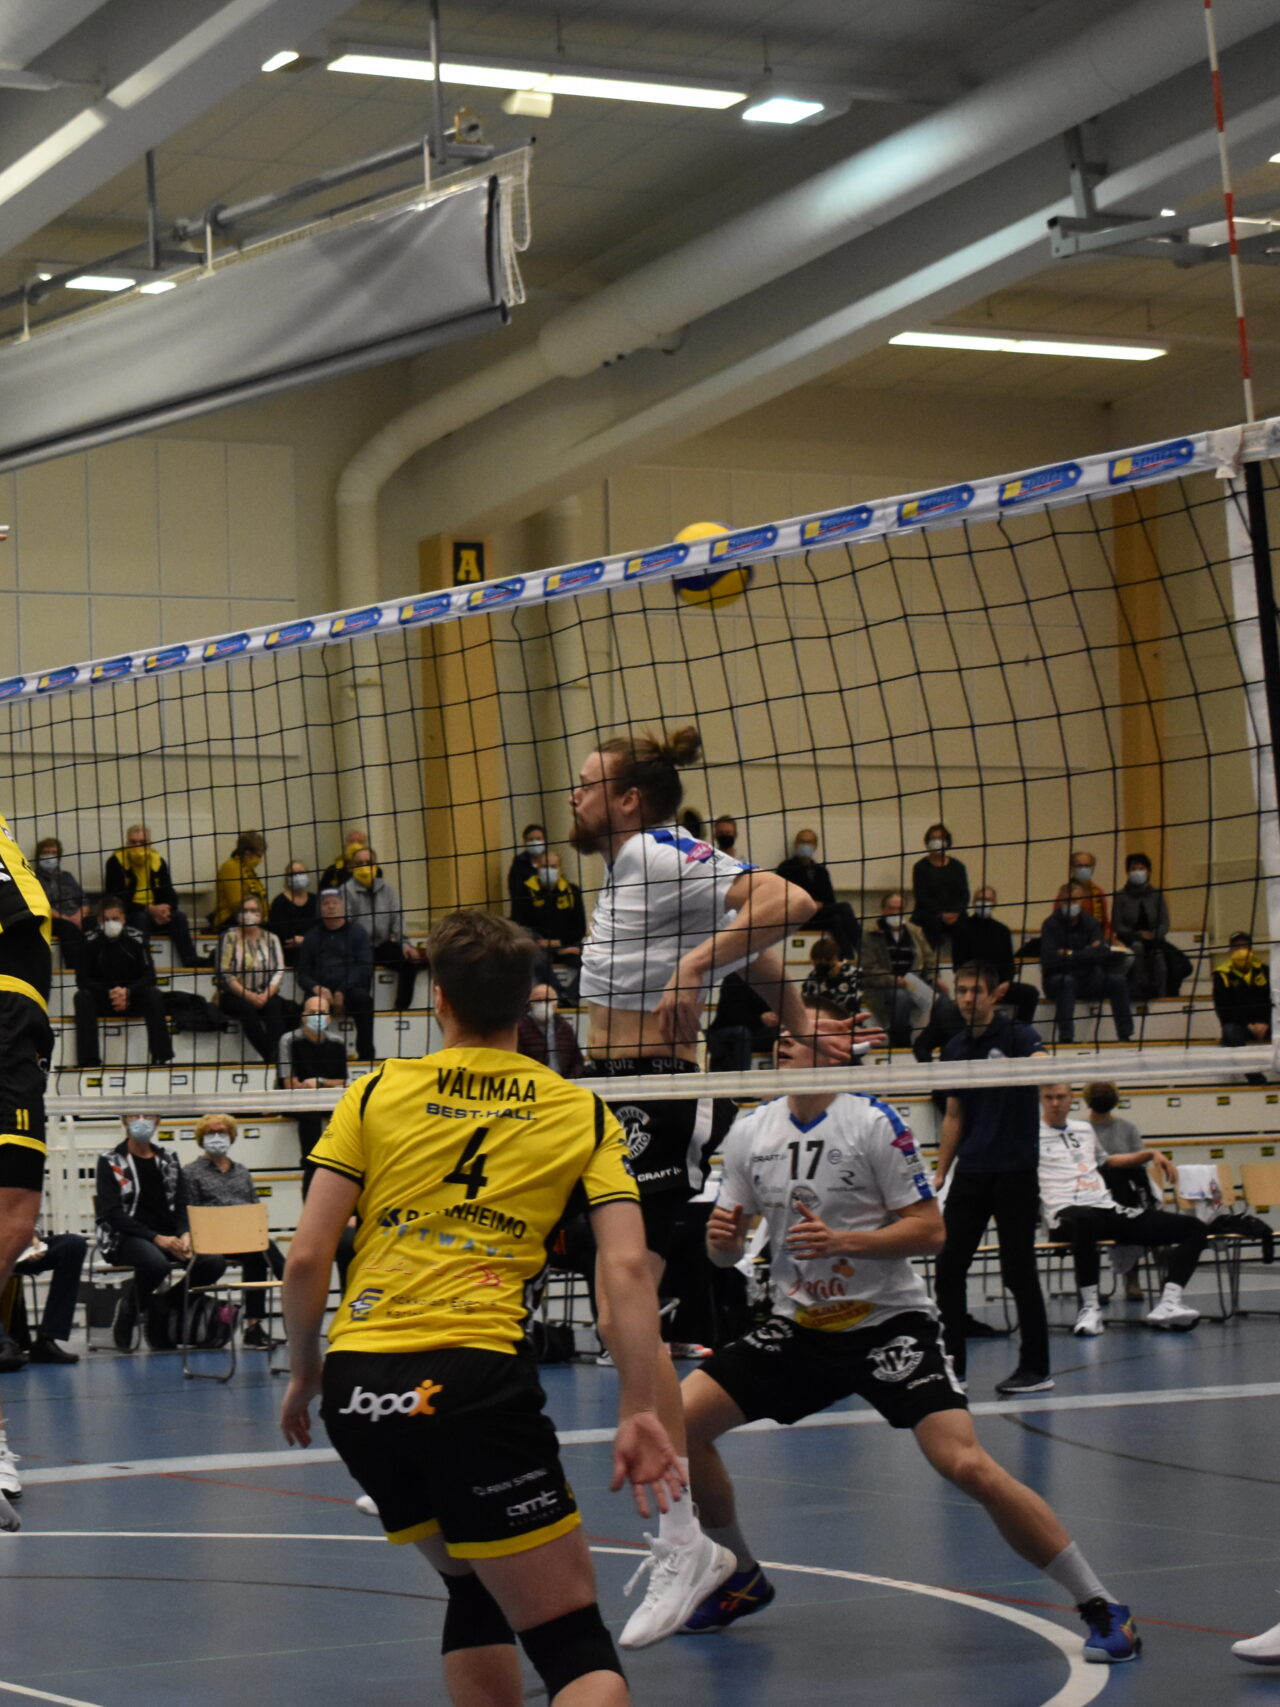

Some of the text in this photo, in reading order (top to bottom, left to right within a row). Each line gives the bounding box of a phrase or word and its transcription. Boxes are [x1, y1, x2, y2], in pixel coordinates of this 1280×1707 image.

[457, 549, 481, 581] A
[437, 1066, 537, 1103] VÄLIMAA
[1060, 1133, 1081, 1150] 15
[442, 1126, 490, 1200] 4
[637, 1168, 671, 1183] CRAFT
[787, 1140, 825, 1180] 17
